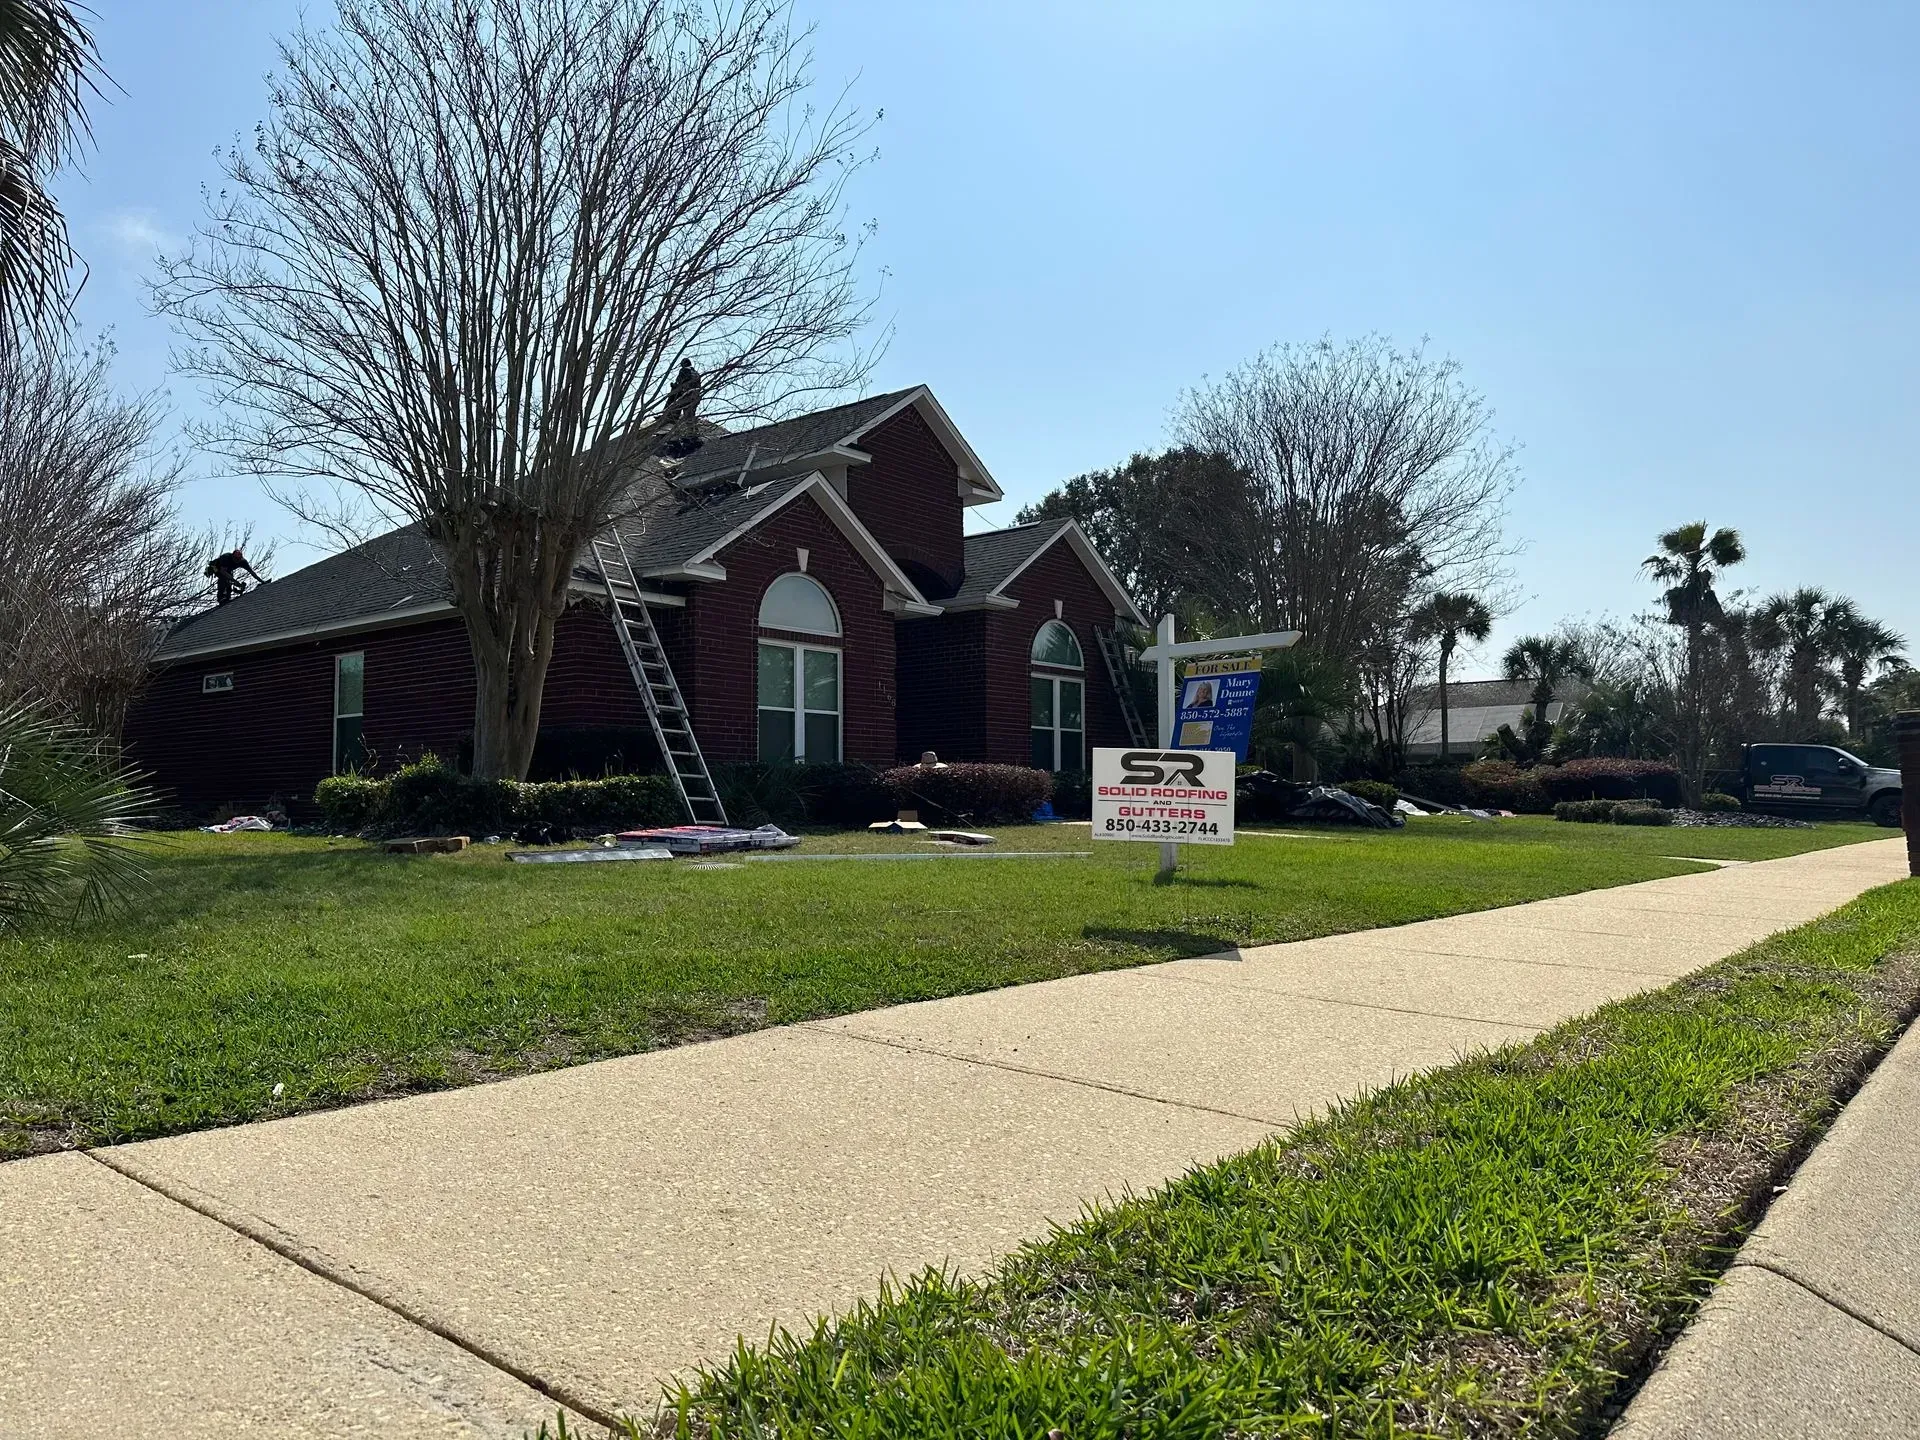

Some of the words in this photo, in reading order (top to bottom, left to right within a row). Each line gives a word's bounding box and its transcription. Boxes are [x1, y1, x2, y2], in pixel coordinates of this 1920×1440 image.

[1195, 665, 1218, 675] FOR
[1222, 661, 1250, 672] SALE
[1226, 678, 1253, 689] Mary
[1220, 689, 1255, 699] Dunne
[1180, 707, 1249, 720] 850-572-5887
[1120, 752, 1206, 787] SR
[1770, 774, 1805, 788] SR
[1098, 786, 1147, 796] SOLID
[1151, 788, 1228, 800] ROOFING
[1118, 806, 1206, 819] GUTTERS
[1105, 818, 1219, 835] 850-433-2744
